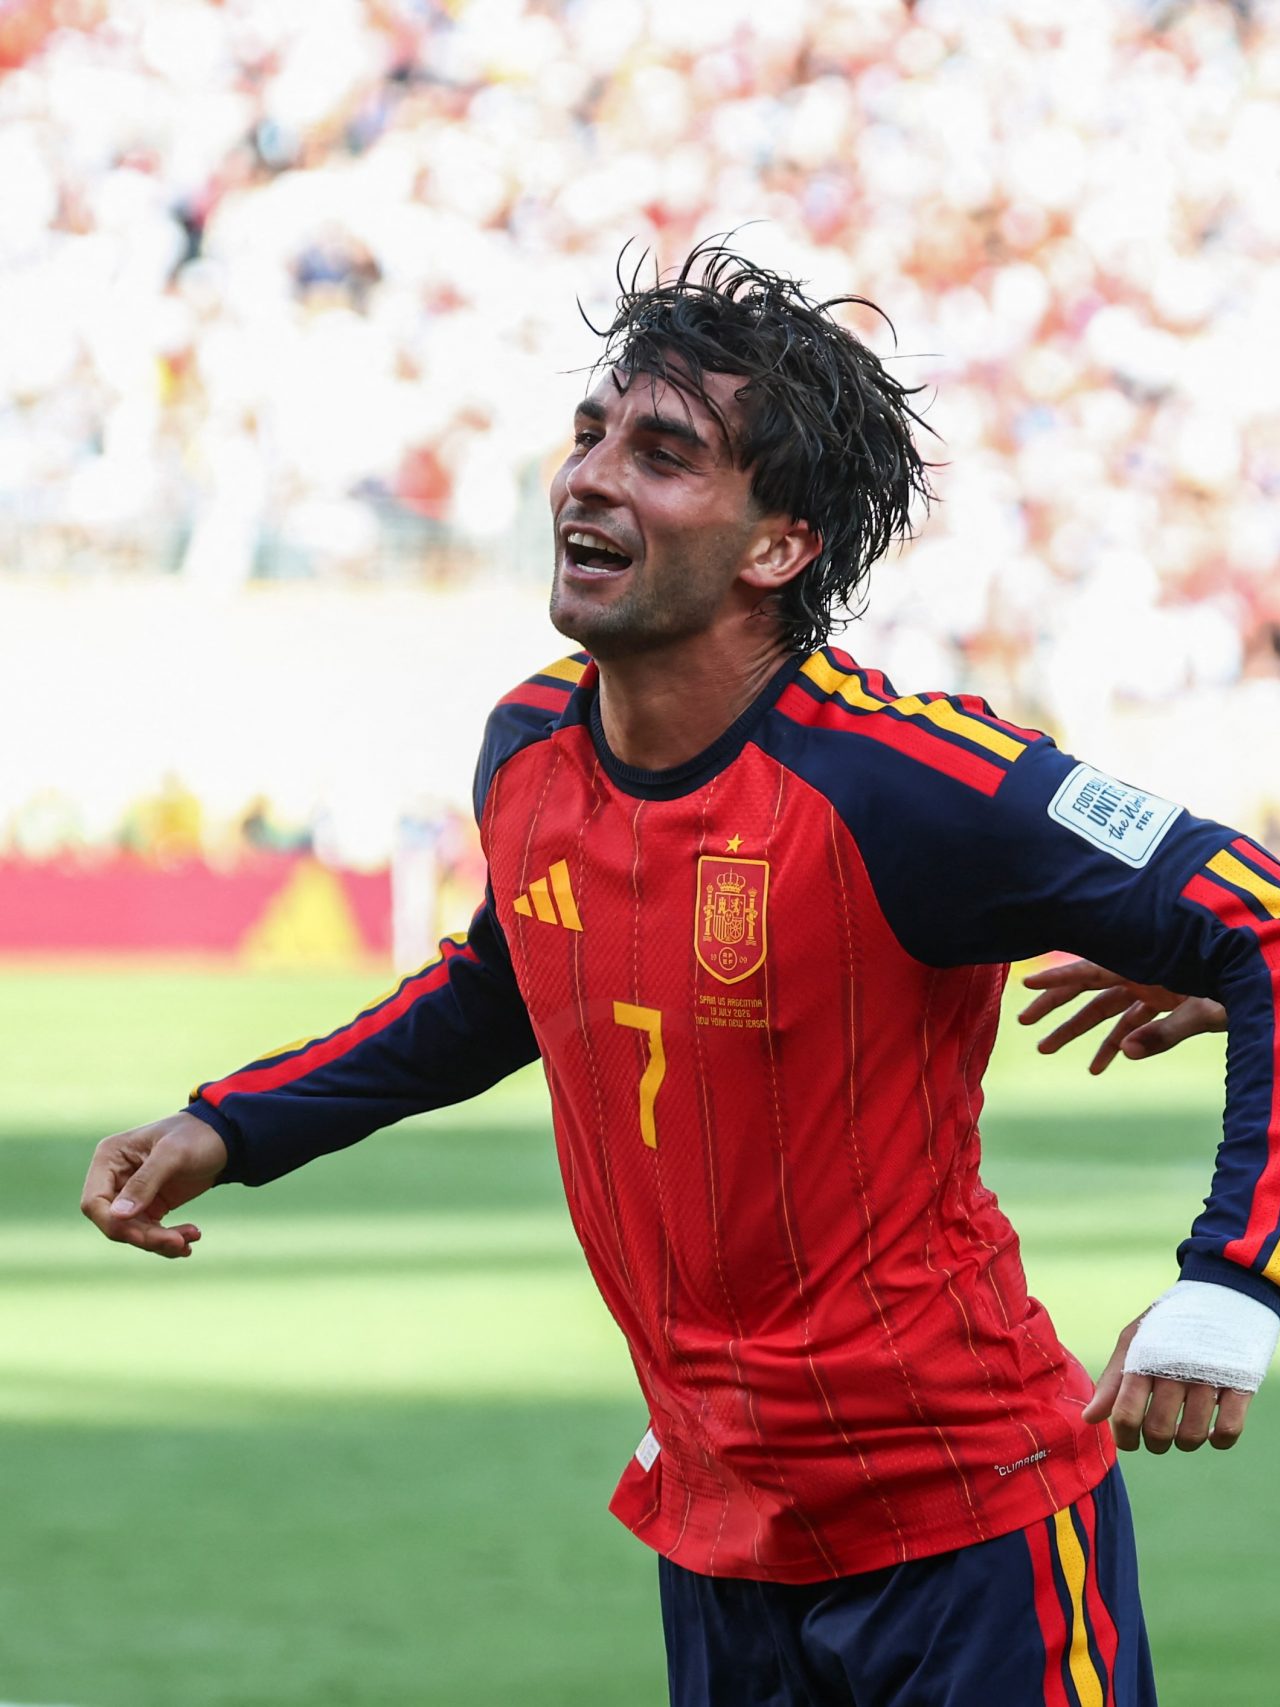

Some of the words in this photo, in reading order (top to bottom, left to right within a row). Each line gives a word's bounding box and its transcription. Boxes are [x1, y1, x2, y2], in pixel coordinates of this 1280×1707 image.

[1087, 786, 1129, 827] UNIT
[1108, 817, 1130, 840] the
[1136, 811, 1155, 832] FIFA
[719, 1007, 732, 1017] JULY
[733, 1008, 751, 1018] 2026
[727, 997, 763, 1008] ARGENTINA
[696, 1016, 710, 1025] NEW
[711, 1017, 727, 1027] YORK
[728, 1019, 743, 1028] NEW
[746, 1019, 769, 1029] JERSEY
[612, 1000, 667, 1150] 7
